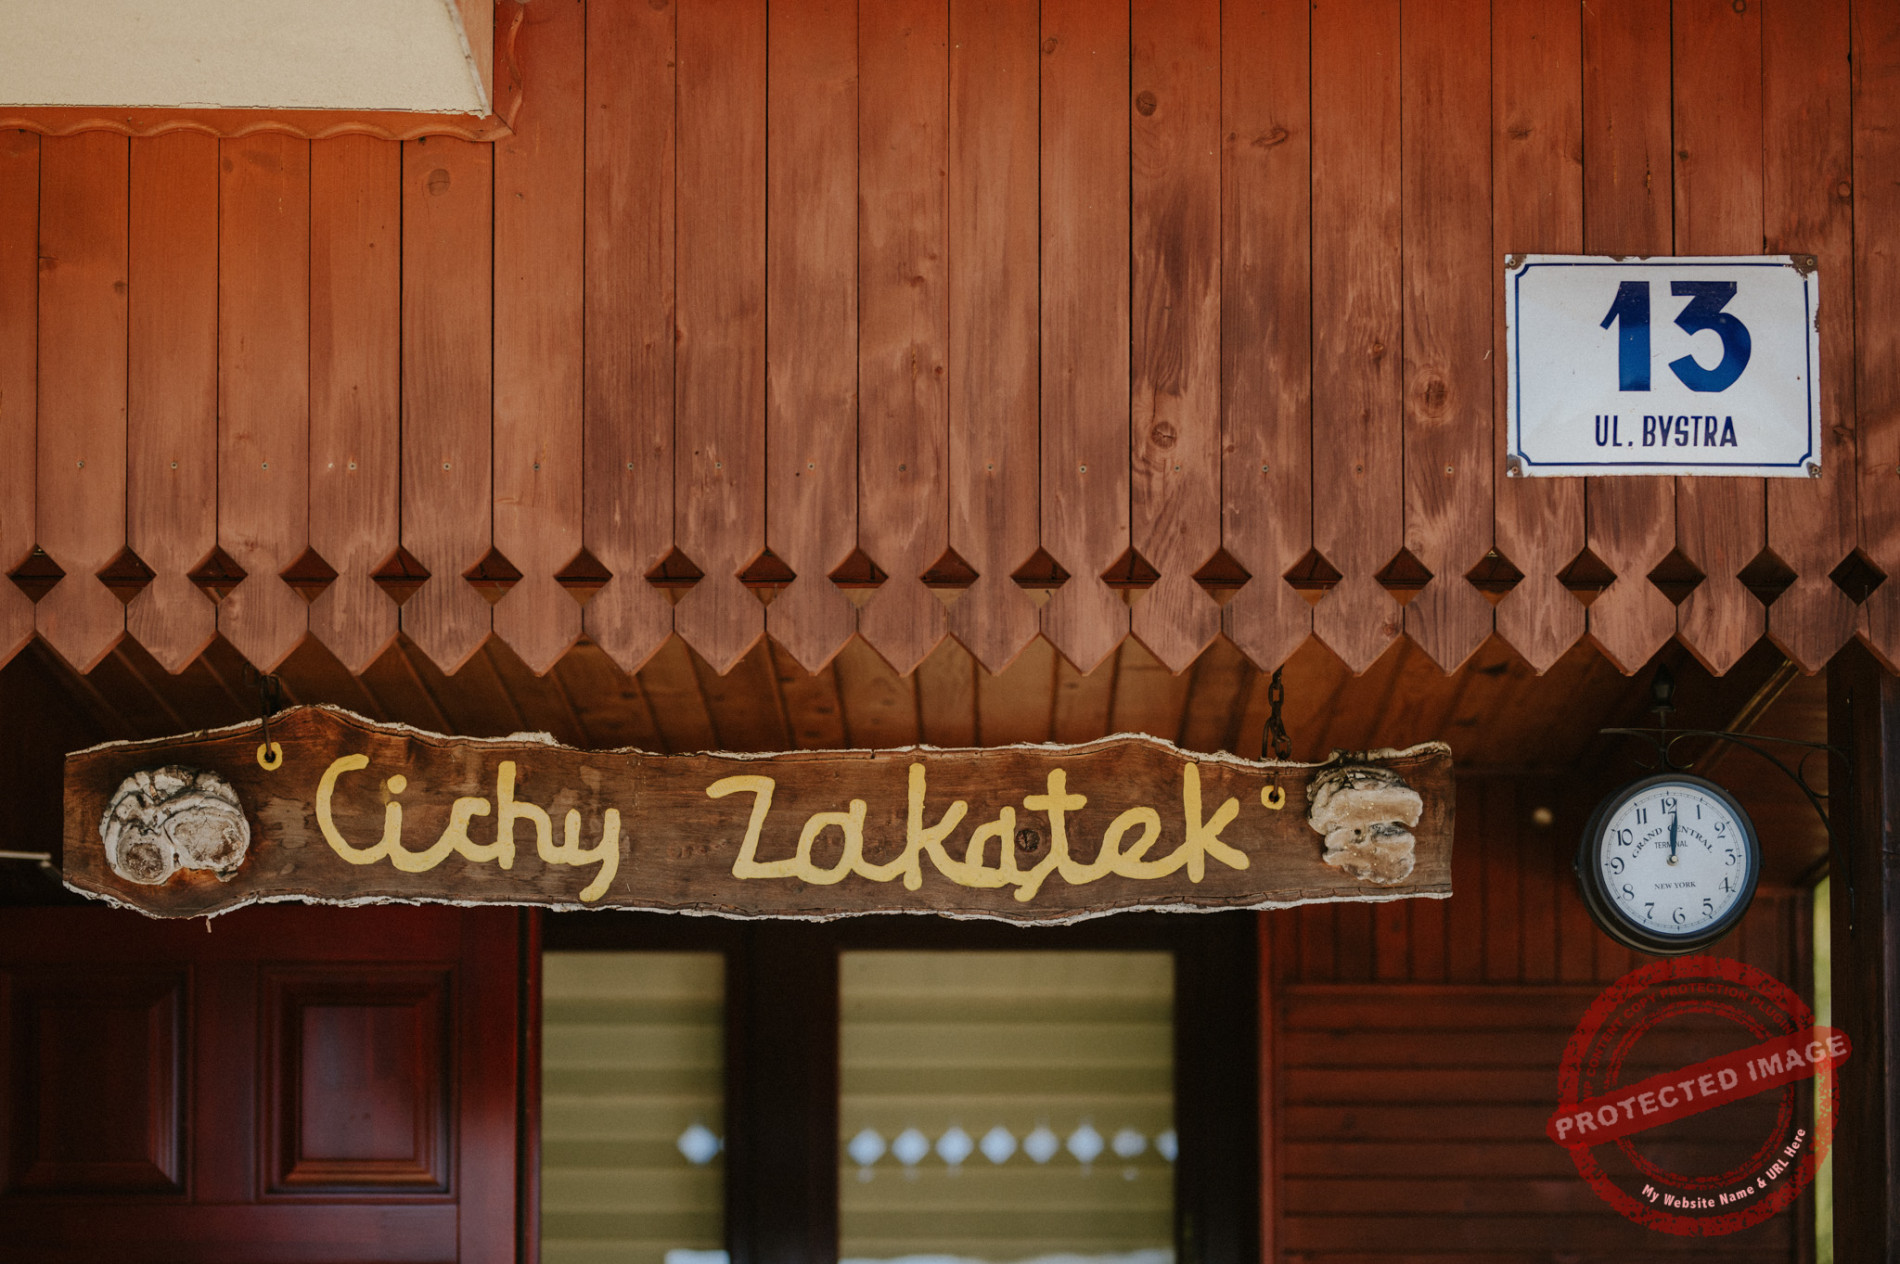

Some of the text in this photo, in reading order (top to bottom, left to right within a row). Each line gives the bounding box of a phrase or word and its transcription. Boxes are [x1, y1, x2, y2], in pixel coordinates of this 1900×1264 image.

[1600, 281, 1751, 392] 13
[1595, 415, 1738, 447] UL. BYSTRA
[1661, 797, 1677, 815] 12
[1696, 804, 1702, 820] 1
[1636, 808, 1647, 825] 11
[316, 753, 1250, 902] Cichy Zakątek
[1714, 822, 1726, 839] 2
[1617, 828, 1634, 847] 10
[1632, 827, 1663, 858] GRAND
[1654, 840, 1689, 850] TERMNAL
[1610, 856, 1625, 875] 9
[1725, 849, 1736, 866] 3
[1622, 883, 1635, 901] 8
[1674, 881, 1696, 889] YORK
[1718, 877, 1733, 893] 4
[1645, 902, 1655, 919] 7
[1672, 907, 1686, 924] 6
[1702, 898, 1714, 917] 5
